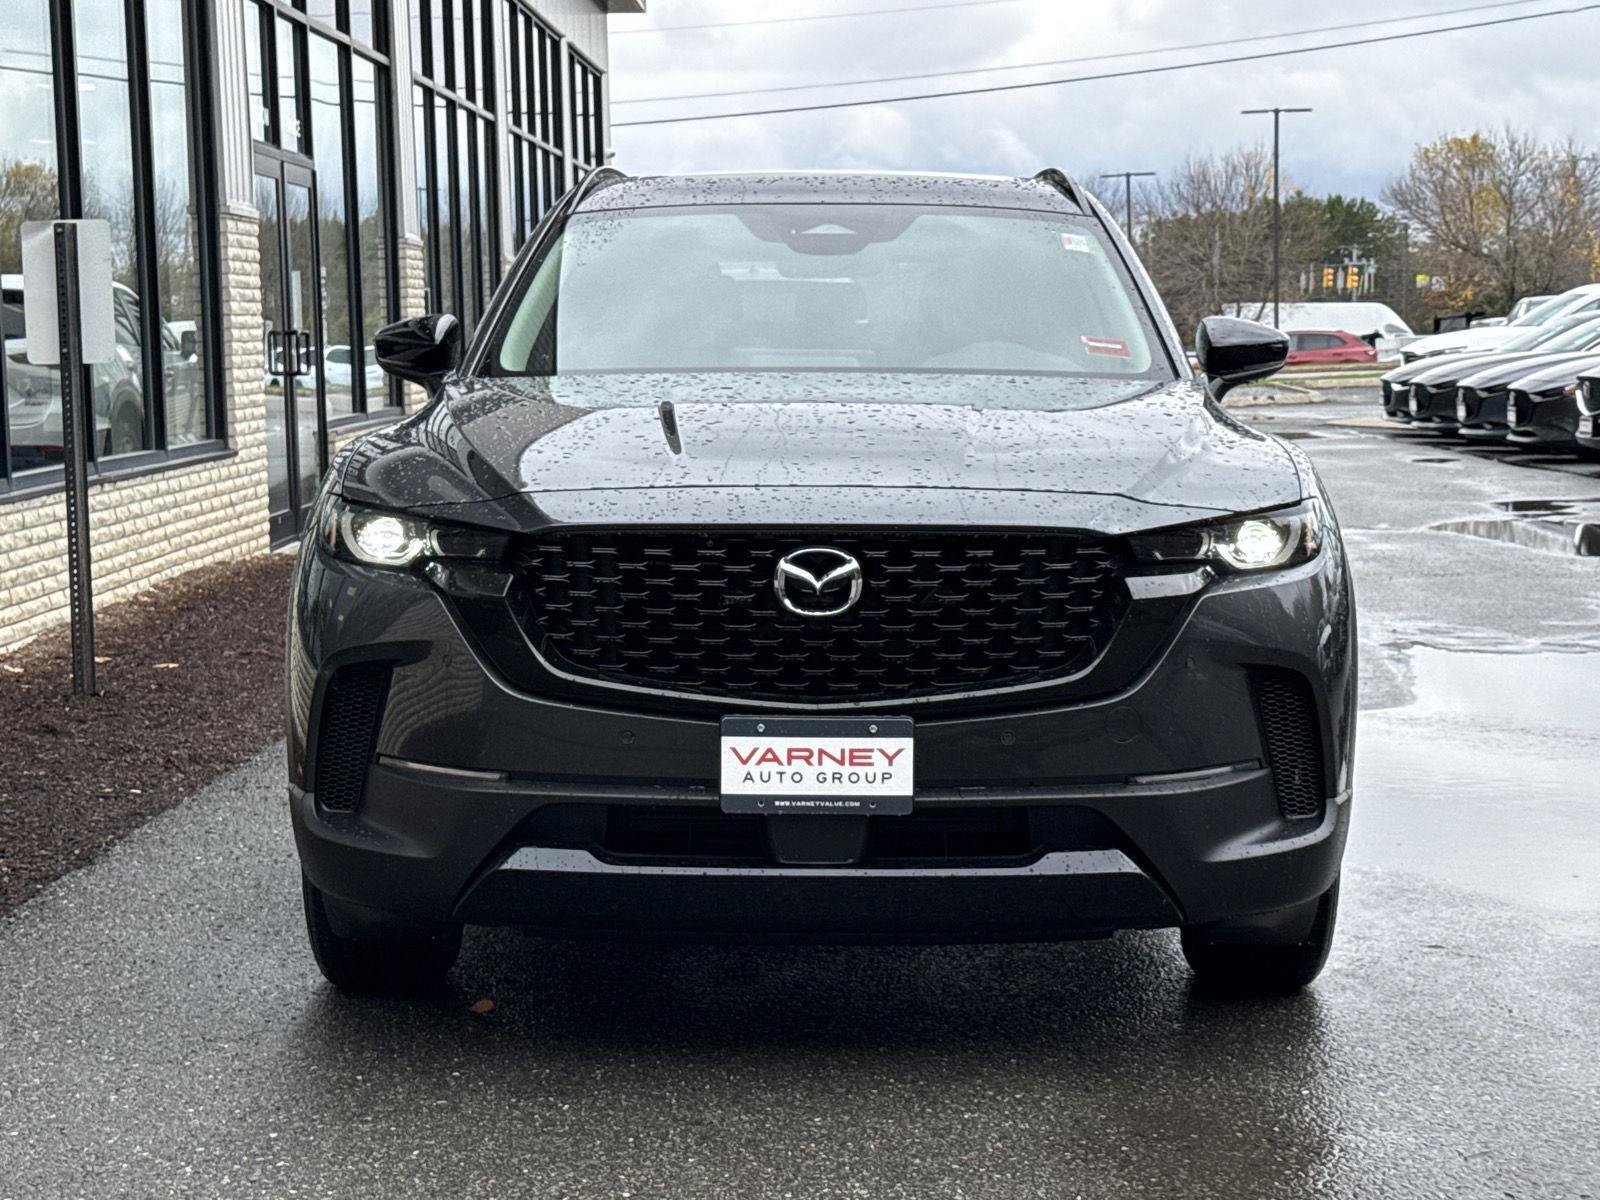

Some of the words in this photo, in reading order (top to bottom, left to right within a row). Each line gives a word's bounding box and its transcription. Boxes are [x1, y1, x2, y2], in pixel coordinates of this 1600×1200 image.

[730, 747, 905, 767] VARNEY
[743, 771, 804, 784] AUTO
[816, 771, 893, 785] GROUP
